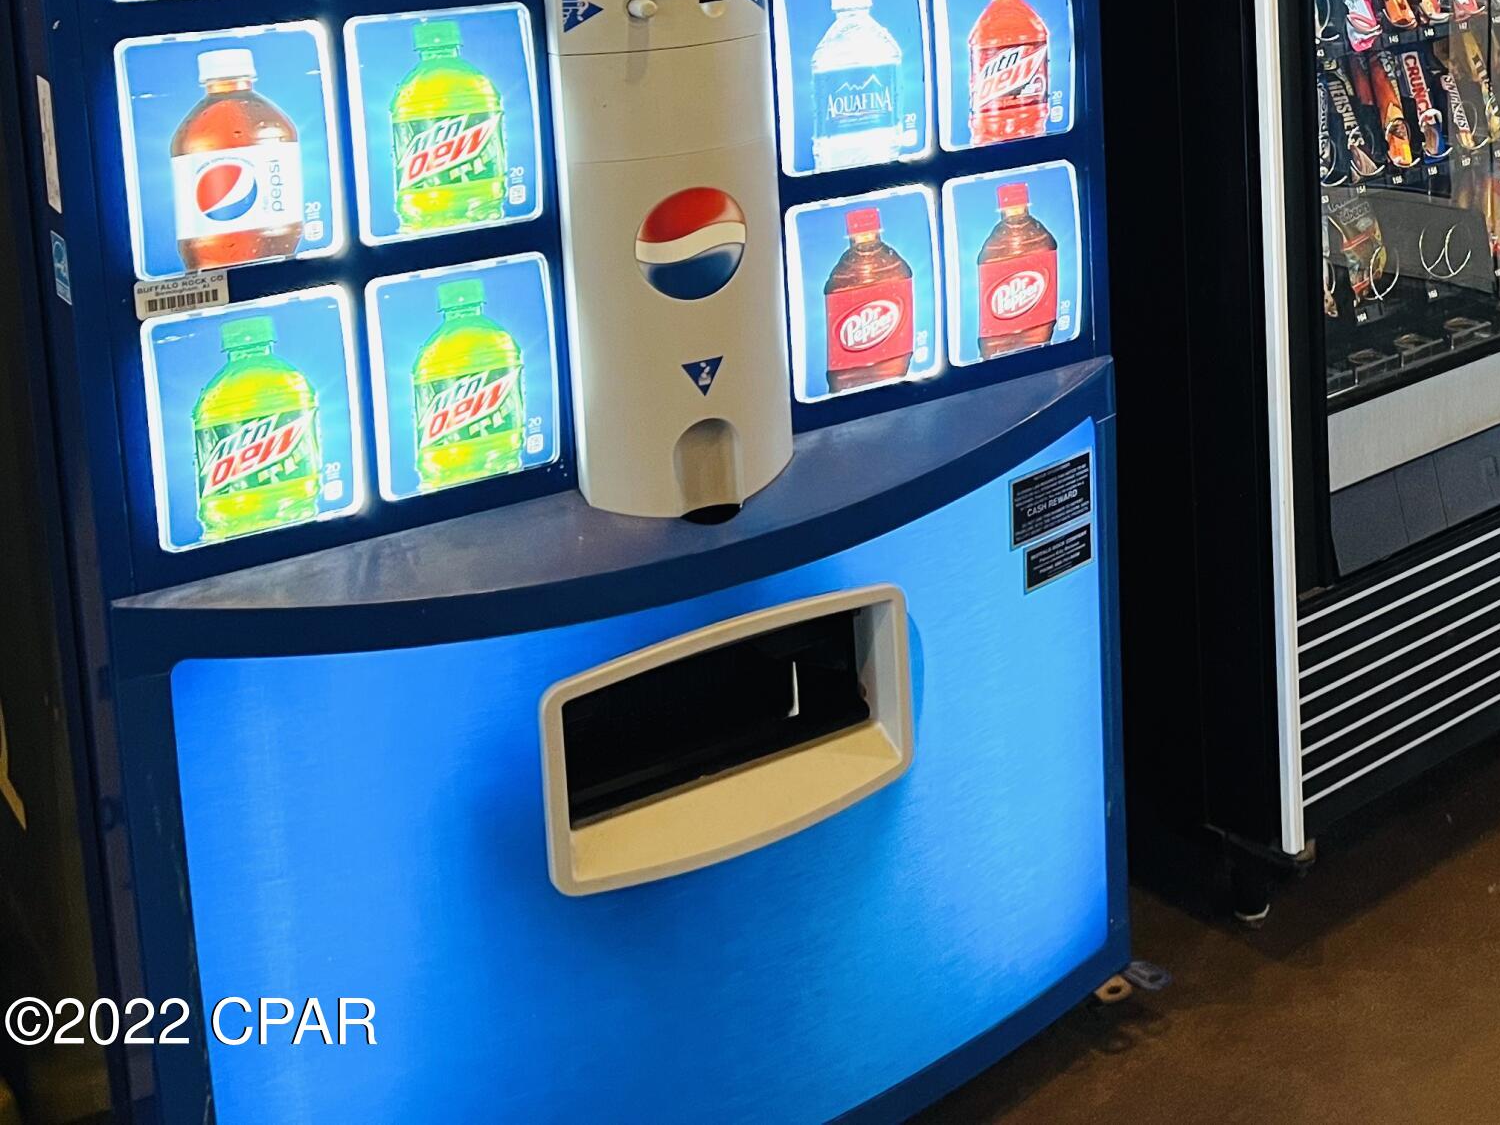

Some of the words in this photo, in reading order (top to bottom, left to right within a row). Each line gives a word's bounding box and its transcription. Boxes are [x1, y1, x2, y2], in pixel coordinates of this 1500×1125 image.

[825, 86, 894, 121] AQUAFINA
[1051, 90, 1062, 100] 20
[904, 112, 917, 123] 20
[509, 166, 525, 177] 20
[268, 159, 285, 212] pepsi
[304, 201, 322, 214] 20
[136, 282, 179, 295] BUFFALO
[210, 274, 224, 283] CO
[1009, 277, 1030, 294] Dr
[997, 281, 1041, 316] Pepper
[1060, 299, 1071, 309] 20
[859, 306, 882, 324] Dr
[842, 311, 894, 347] Pepper
[527, 416, 542, 429] 20
[324, 461, 341, 475] 20
[1026, 500, 1048, 517] CASH
[1048, 488, 1079, 508] REWARD
